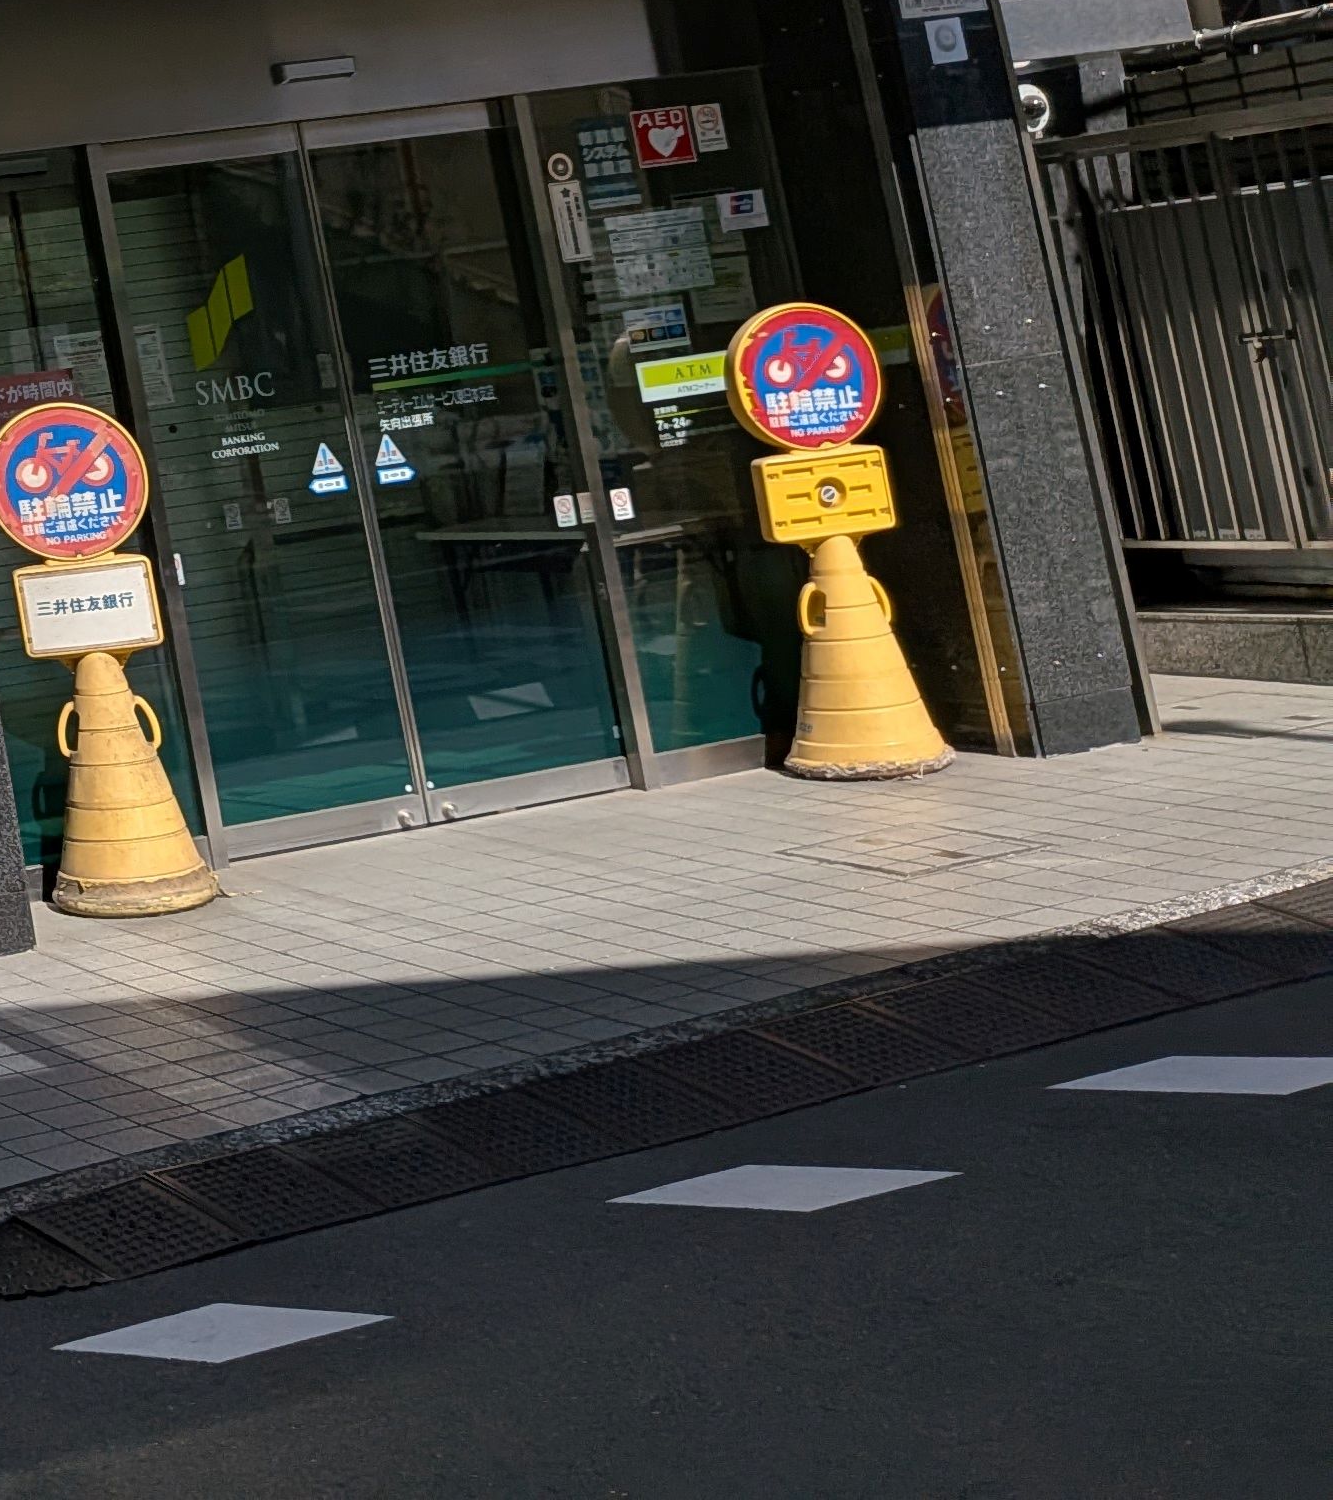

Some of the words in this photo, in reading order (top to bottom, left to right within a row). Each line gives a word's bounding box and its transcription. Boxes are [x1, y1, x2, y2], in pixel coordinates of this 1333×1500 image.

[638, 109, 683, 129] AED
[368, 343, 489, 379] 三井住友銀行
[675, 364, 712, 380] ATM
[195, 371, 276, 406] SMBC
[765, 385, 862, 415] 駐輪禁止
[221, 432, 266, 447] BANKING
[790, 428, 806, 437] NO
[807, 424, 846, 436] PARKING
[211, 442, 280, 459] CORPORATION
[18, 488, 126, 523] 駐輪禁止
[46, 536, 61, 546] NO
[64, 531, 108, 544] PARKING
[37, 591, 134, 617] 三井住友銀行
